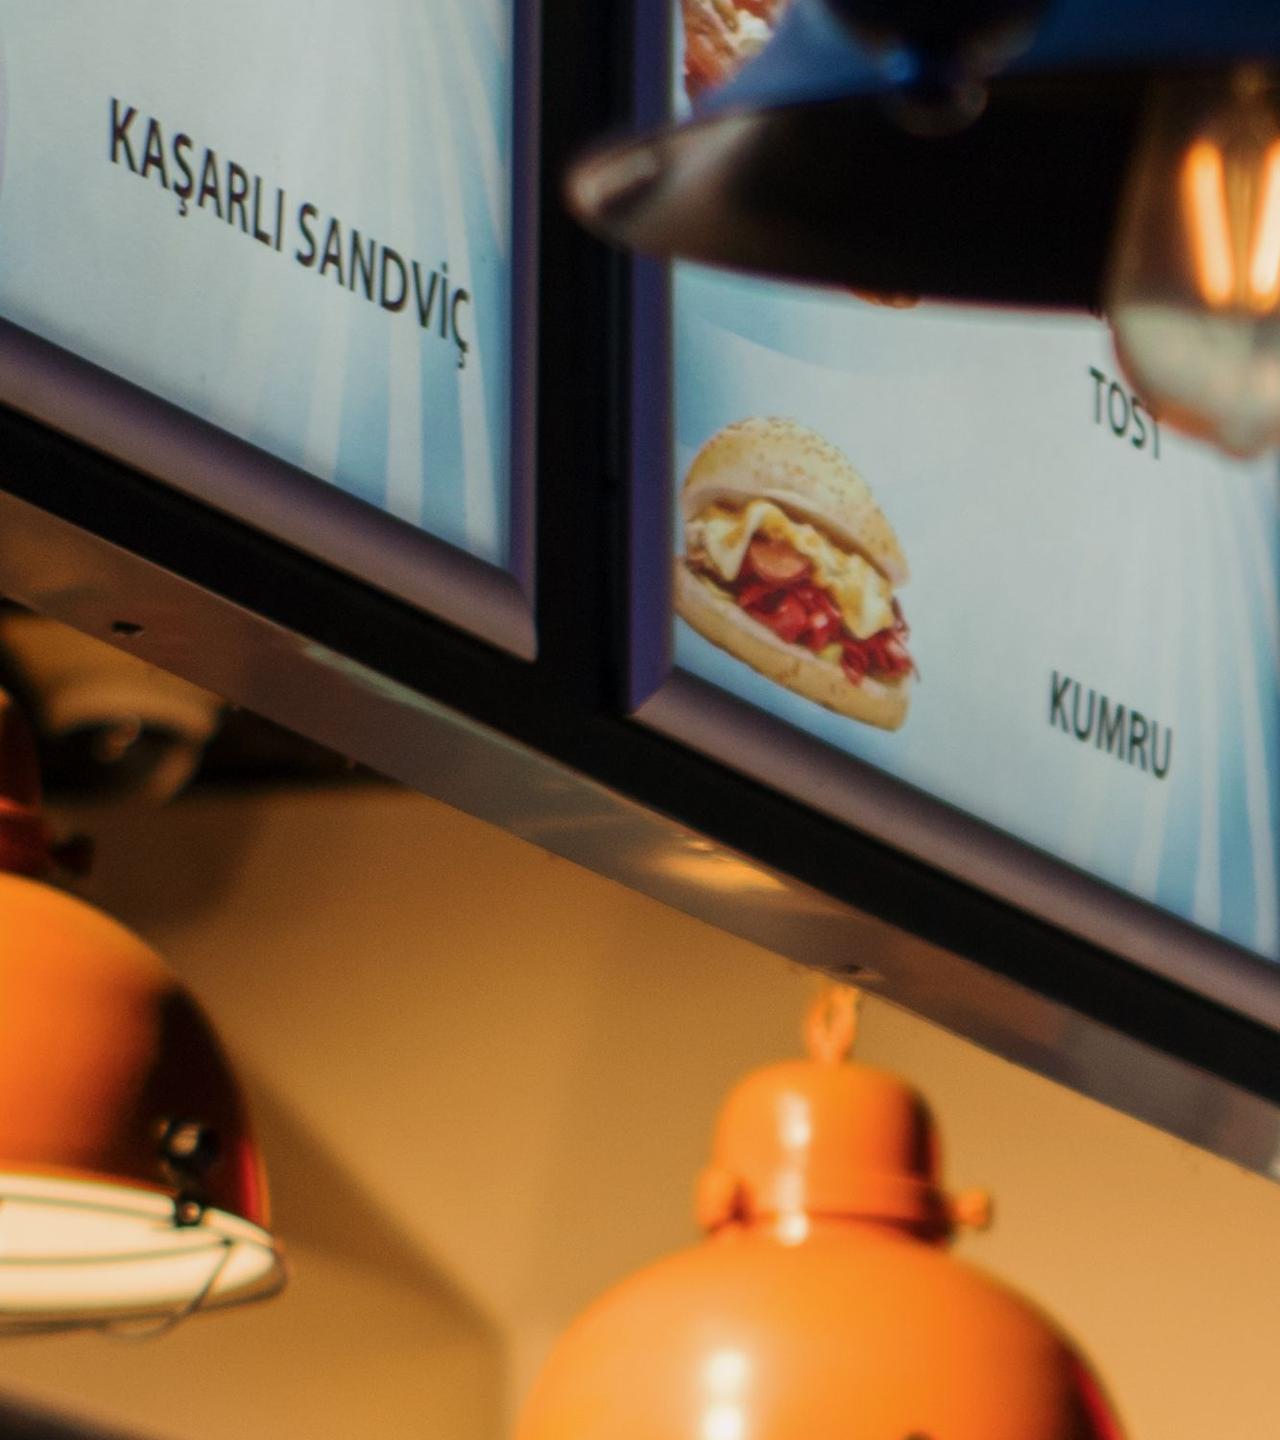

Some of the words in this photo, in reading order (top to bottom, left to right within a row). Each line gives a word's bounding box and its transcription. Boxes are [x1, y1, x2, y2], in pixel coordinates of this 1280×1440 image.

[109, 97, 285, 252] KAŞARLI
[295, 201, 470, 369] SANDVİÇ
[1049, 670, 1173, 781] KUMRU
